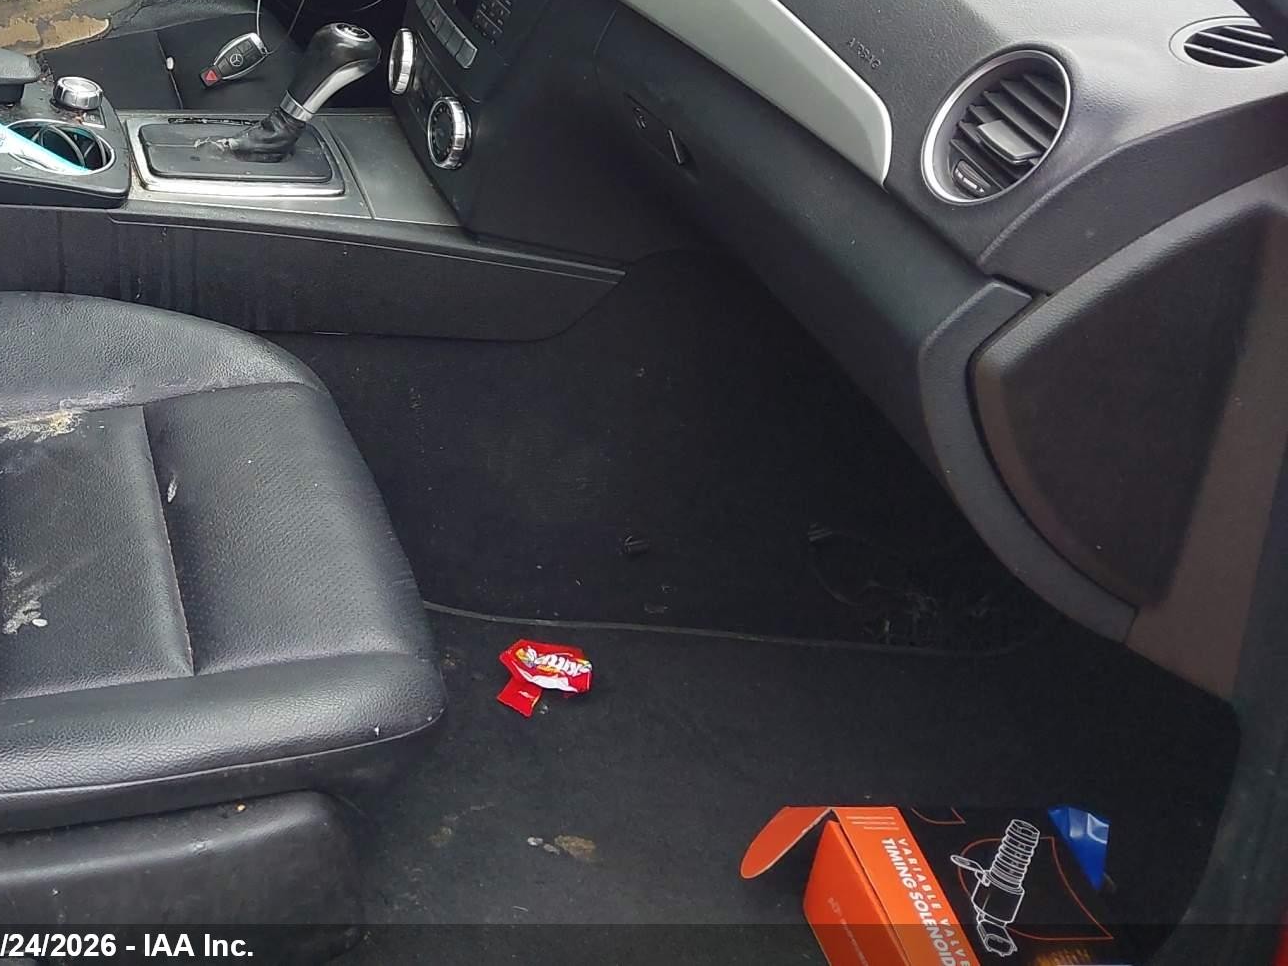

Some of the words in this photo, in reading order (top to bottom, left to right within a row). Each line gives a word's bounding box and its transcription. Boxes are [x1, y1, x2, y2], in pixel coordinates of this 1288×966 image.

[881, 838, 918, 889] TIMING
[898, 837, 942, 909] VARIABLE
[940, 918, 971, 966] VALVE
